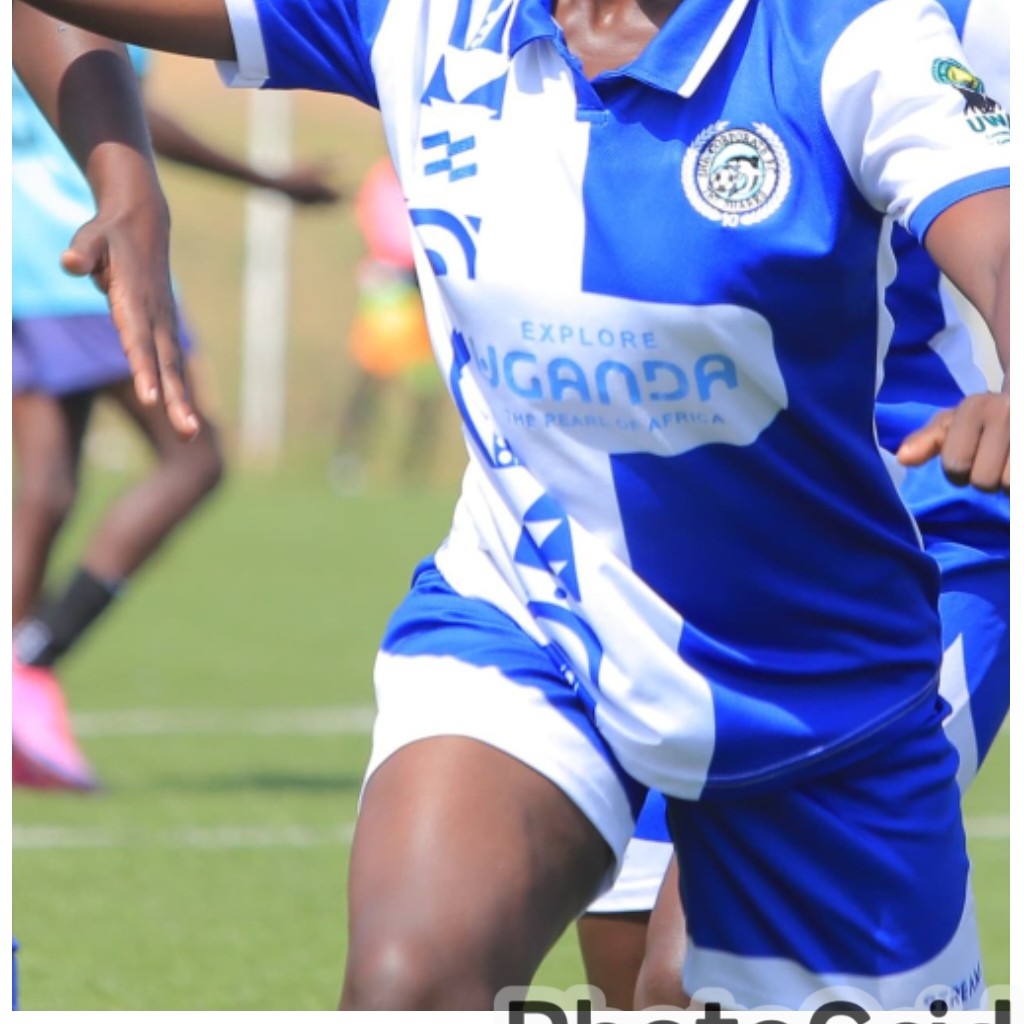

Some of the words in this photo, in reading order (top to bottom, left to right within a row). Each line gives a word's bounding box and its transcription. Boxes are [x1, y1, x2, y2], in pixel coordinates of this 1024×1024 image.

[966, 114, 1010, 134] UW
[521, 321, 658, 350] EXPLORE
[469, 337, 739, 406] UGANDA
[506, 409, 534, 426] THE
[544, 412, 605, 429] PEARL
[648, 412, 725, 433] AFRICA
